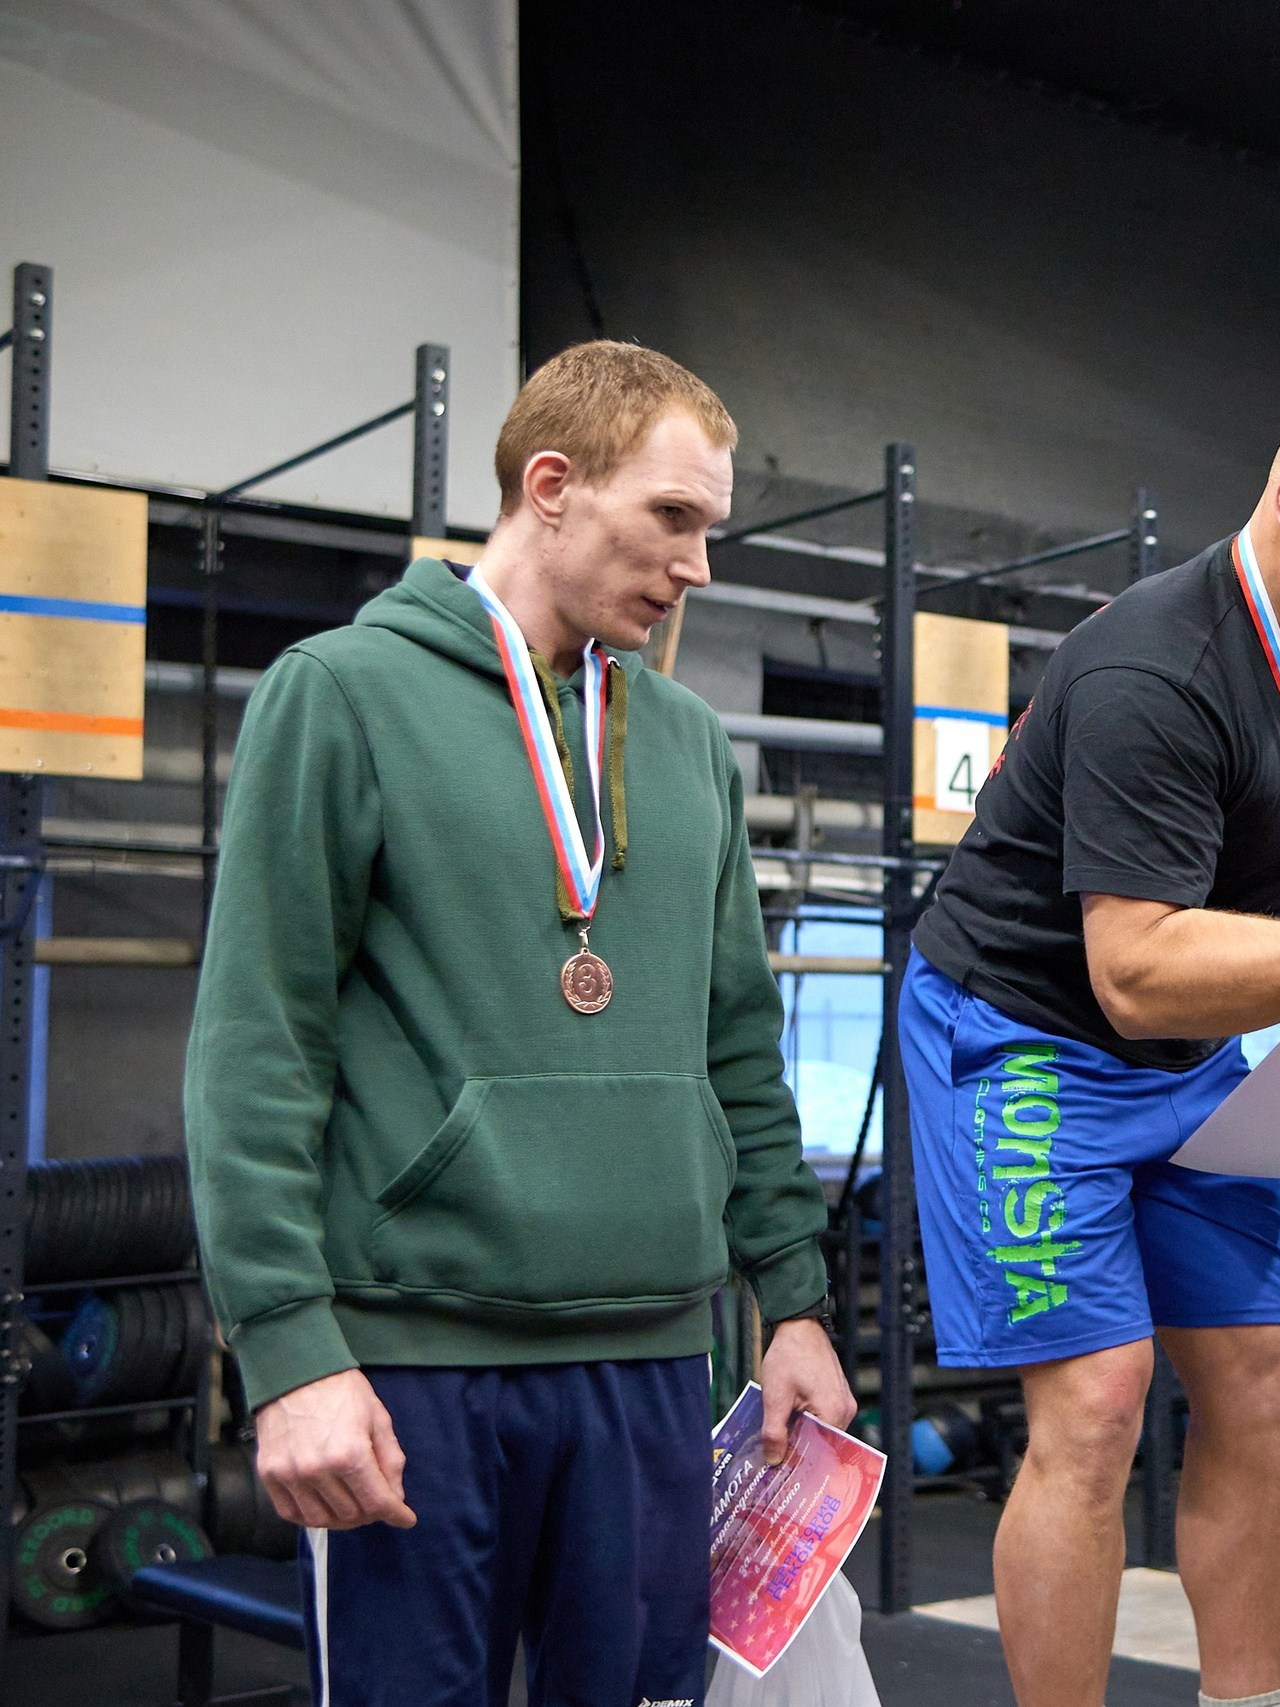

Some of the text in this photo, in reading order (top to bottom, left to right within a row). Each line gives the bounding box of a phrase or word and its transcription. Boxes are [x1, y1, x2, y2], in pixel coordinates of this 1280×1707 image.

[949, 753, 977, 805] 4
[578, 963, 598, 994] 3
[974, 1077, 991, 1192] CLOTHING
[710, 1459, 754, 1526] АМОТА
[710, 1461, 770, 1554] аграждаетс
[769, 1481, 800, 1527] место
[765, 1494, 833, 1595] ТЕРРИТОРИЯ
[772, 1497, 842, 1601] РЕКОРДОВ
